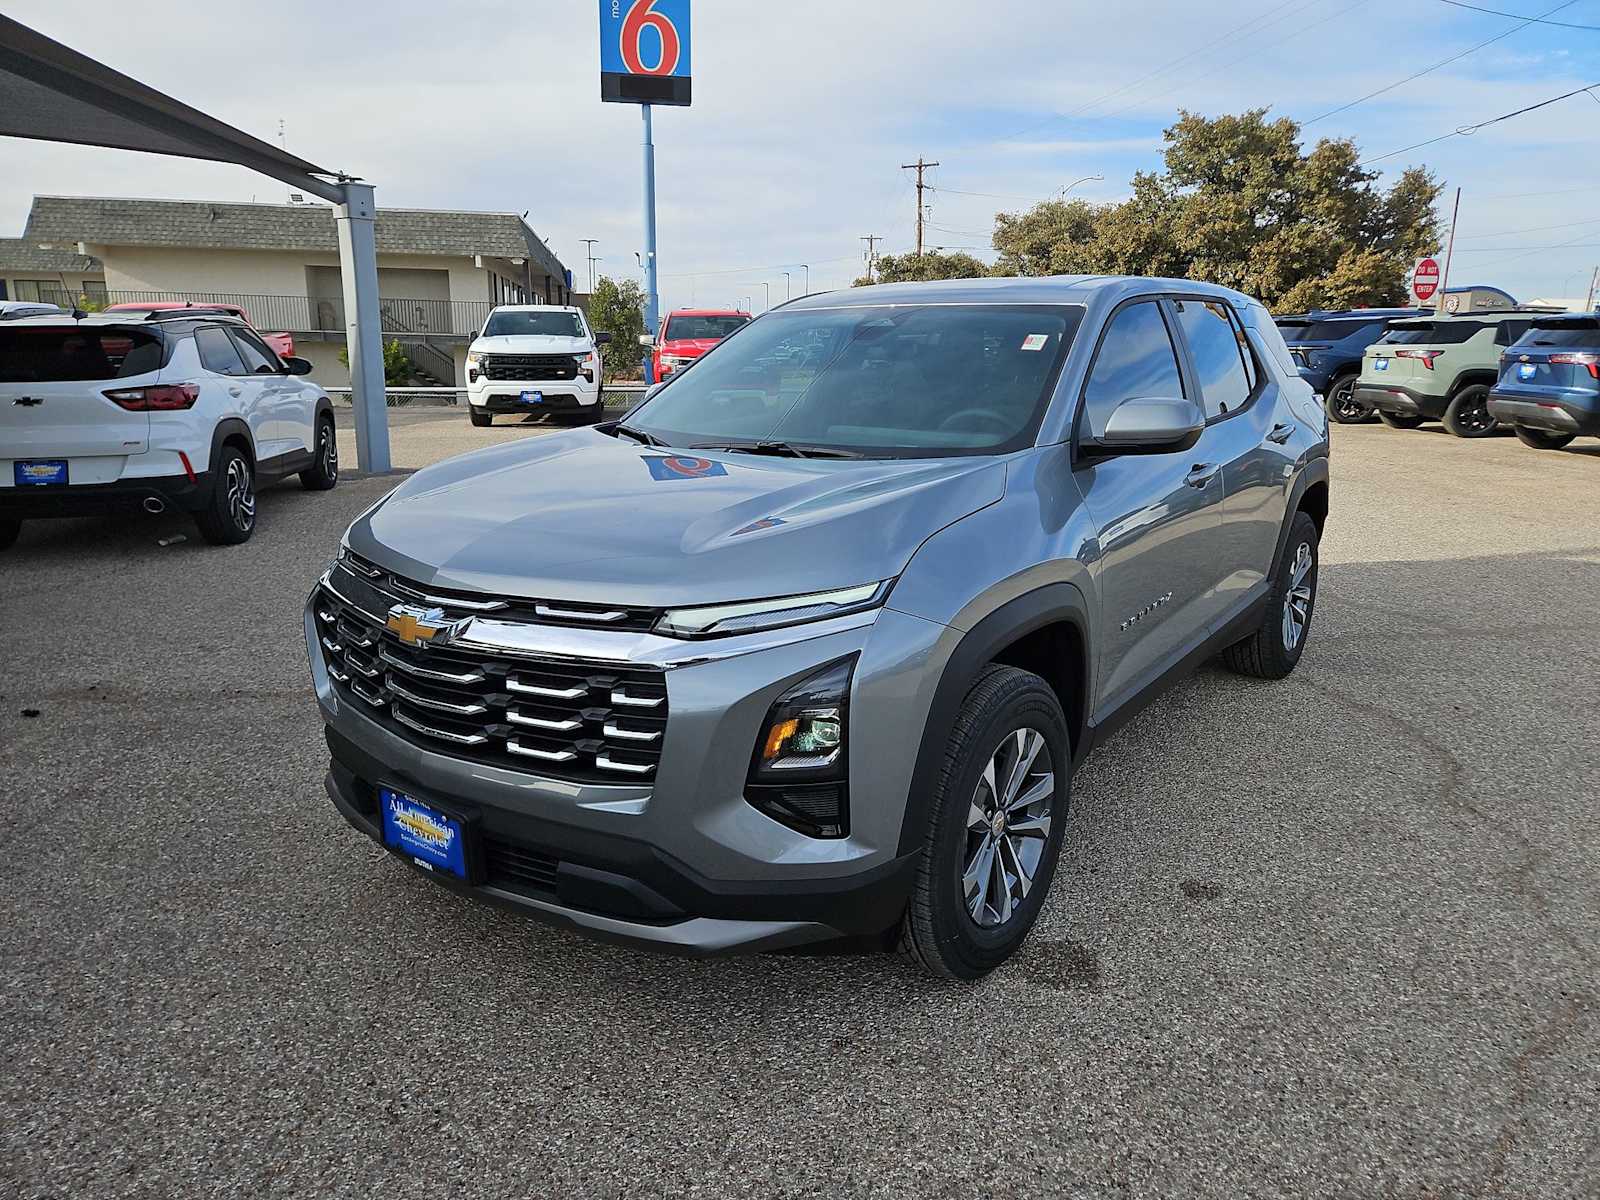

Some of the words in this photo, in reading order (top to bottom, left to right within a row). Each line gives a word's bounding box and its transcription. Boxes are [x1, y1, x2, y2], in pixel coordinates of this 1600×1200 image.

[620, 0, 680, 76] 6
[1417, 266, 1425, 274] DO
[1427, 266, 1437, 274] NOT
[1416, 285, 1433, 293] ENTER
[407, 808, 455, 838] American
